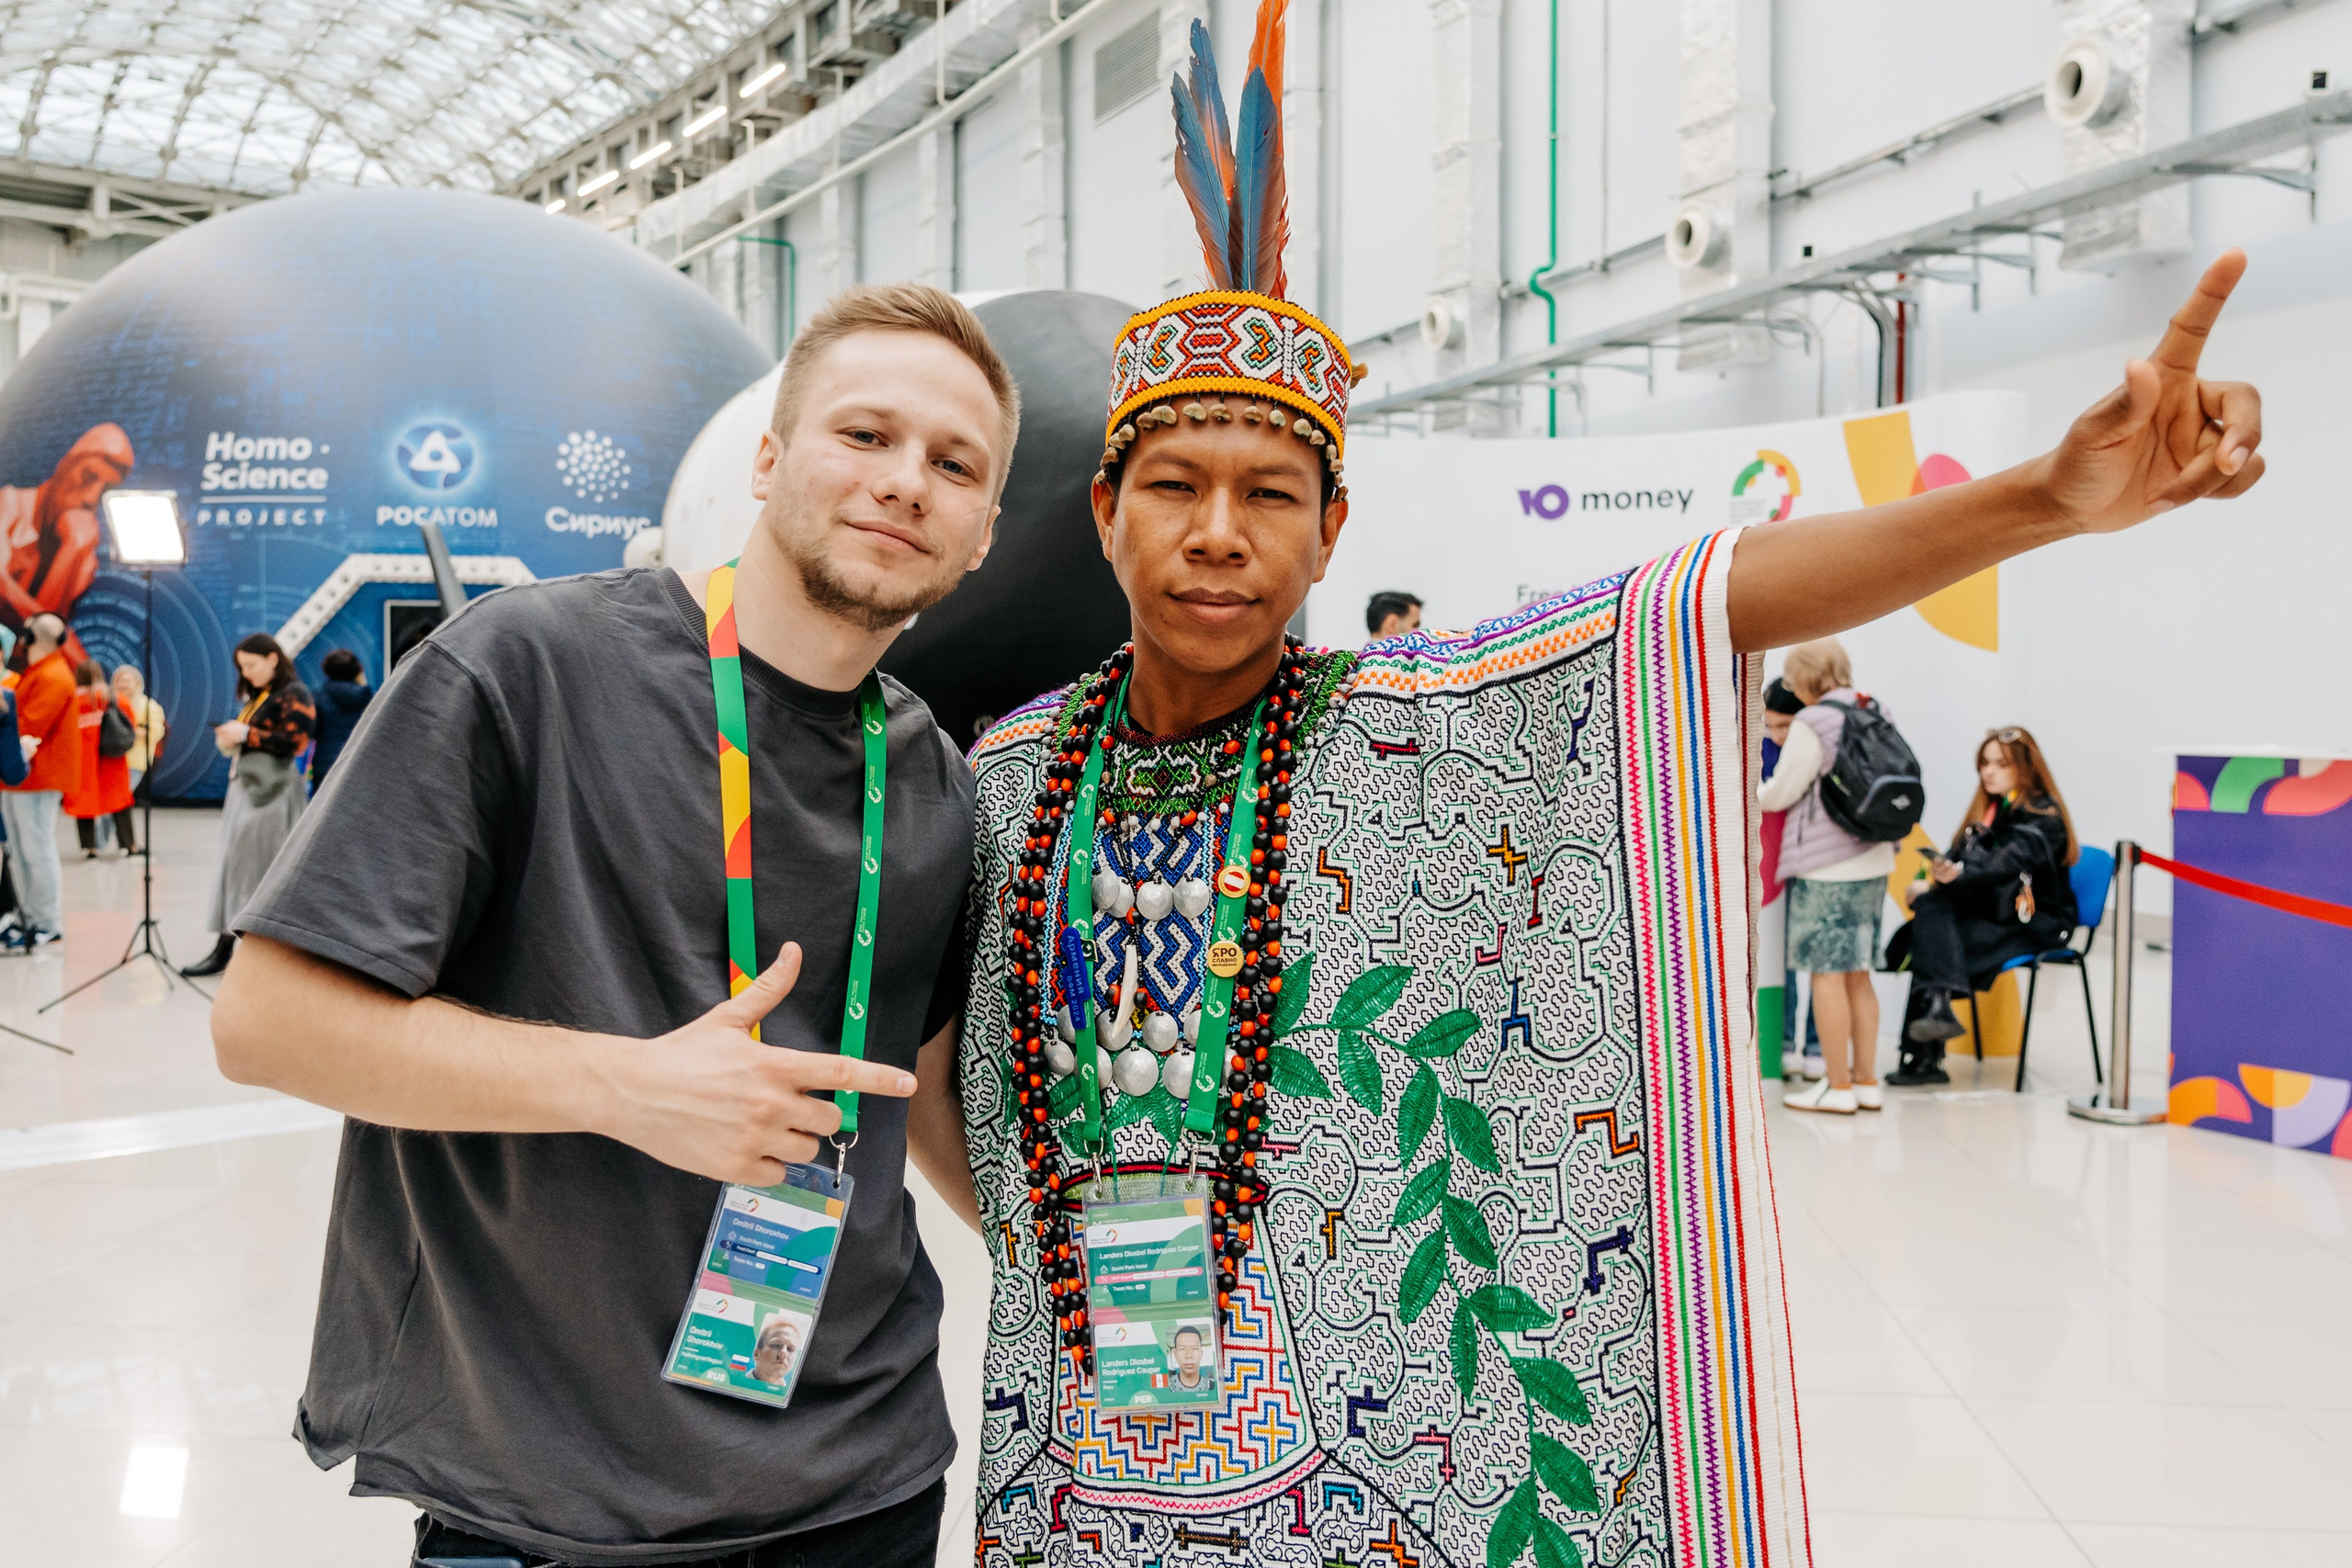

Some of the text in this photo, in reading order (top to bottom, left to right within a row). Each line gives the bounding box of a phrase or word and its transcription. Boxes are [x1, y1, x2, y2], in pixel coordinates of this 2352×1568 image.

[205, 431, 312, 461] Homo
[200, 460, 329, 491] Science
[1582, 490, 1693, 513] money
[197, 508, 327, 526] PROJECT
[377, 505, 498, 527] РОСАТОМ
[1067, 935, 1084, 994] Армения
[1067, 976, 1080, 1021] ВФМ 2024
[1099, 1251, 1124, 1259] Landers
[1102, 1359, 1128, 1368] Landers
[707, 1371, 726, 1382] RUS
[1135, 1395, 1152, 1404] PER
